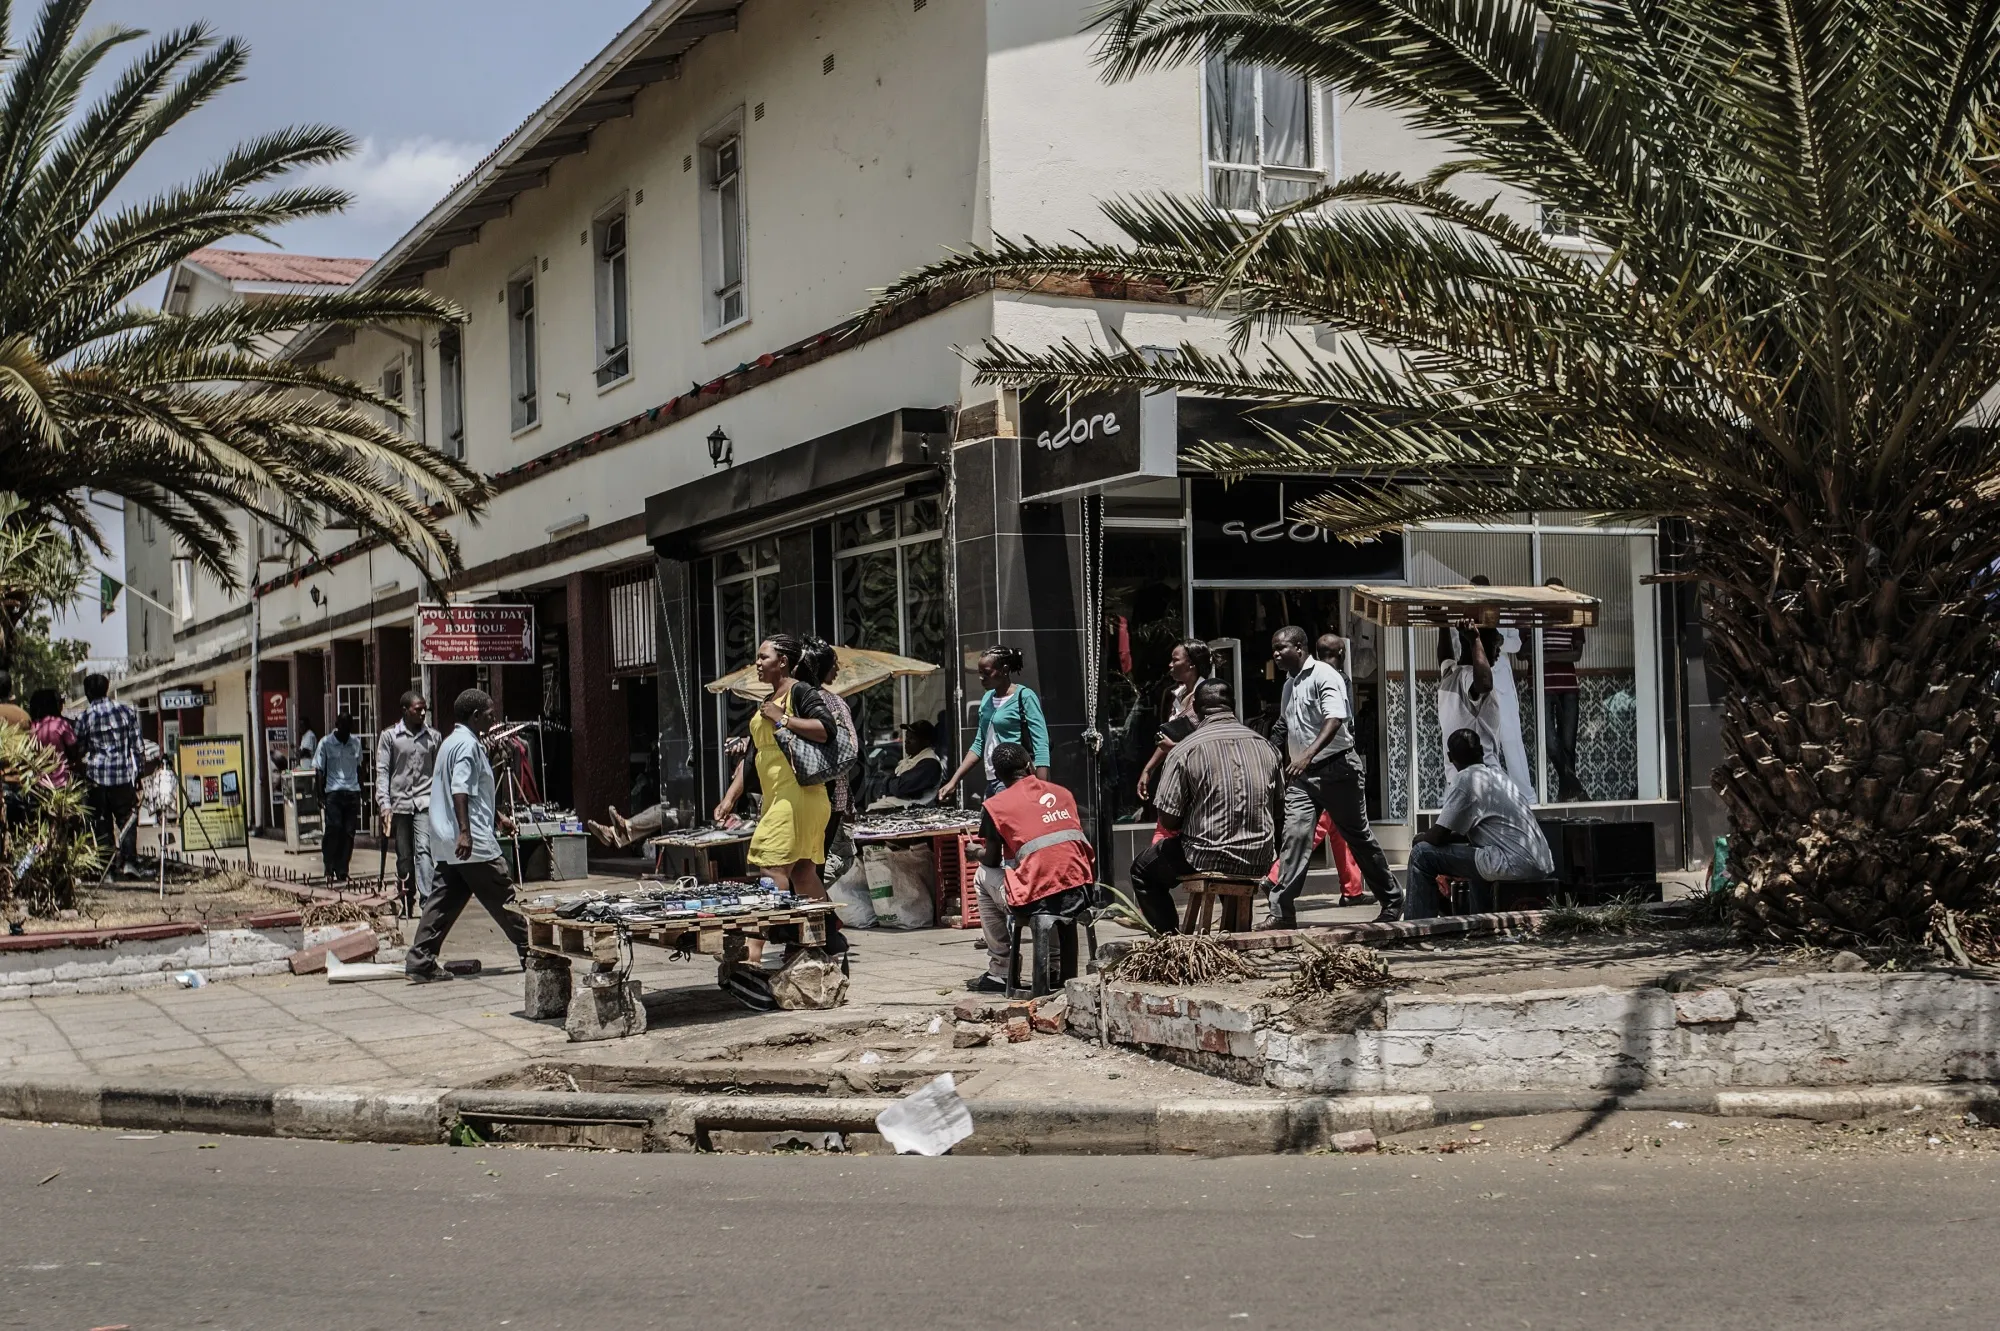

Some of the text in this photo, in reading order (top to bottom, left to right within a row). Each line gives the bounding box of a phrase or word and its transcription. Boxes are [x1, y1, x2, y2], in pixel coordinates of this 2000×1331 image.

[1037, 390, 1120, 450] adore
[1222, 482, 1374, 543] ador
[422, 610, 523, 619] YOUR LUCKY DAY
[445, 624, 506, 634] BOUTIQUE
[165, 694, 210, 707] POLICE
[197, 758, 225, 766] CENTRE
[1042, 808, 1071, 823] airtel
